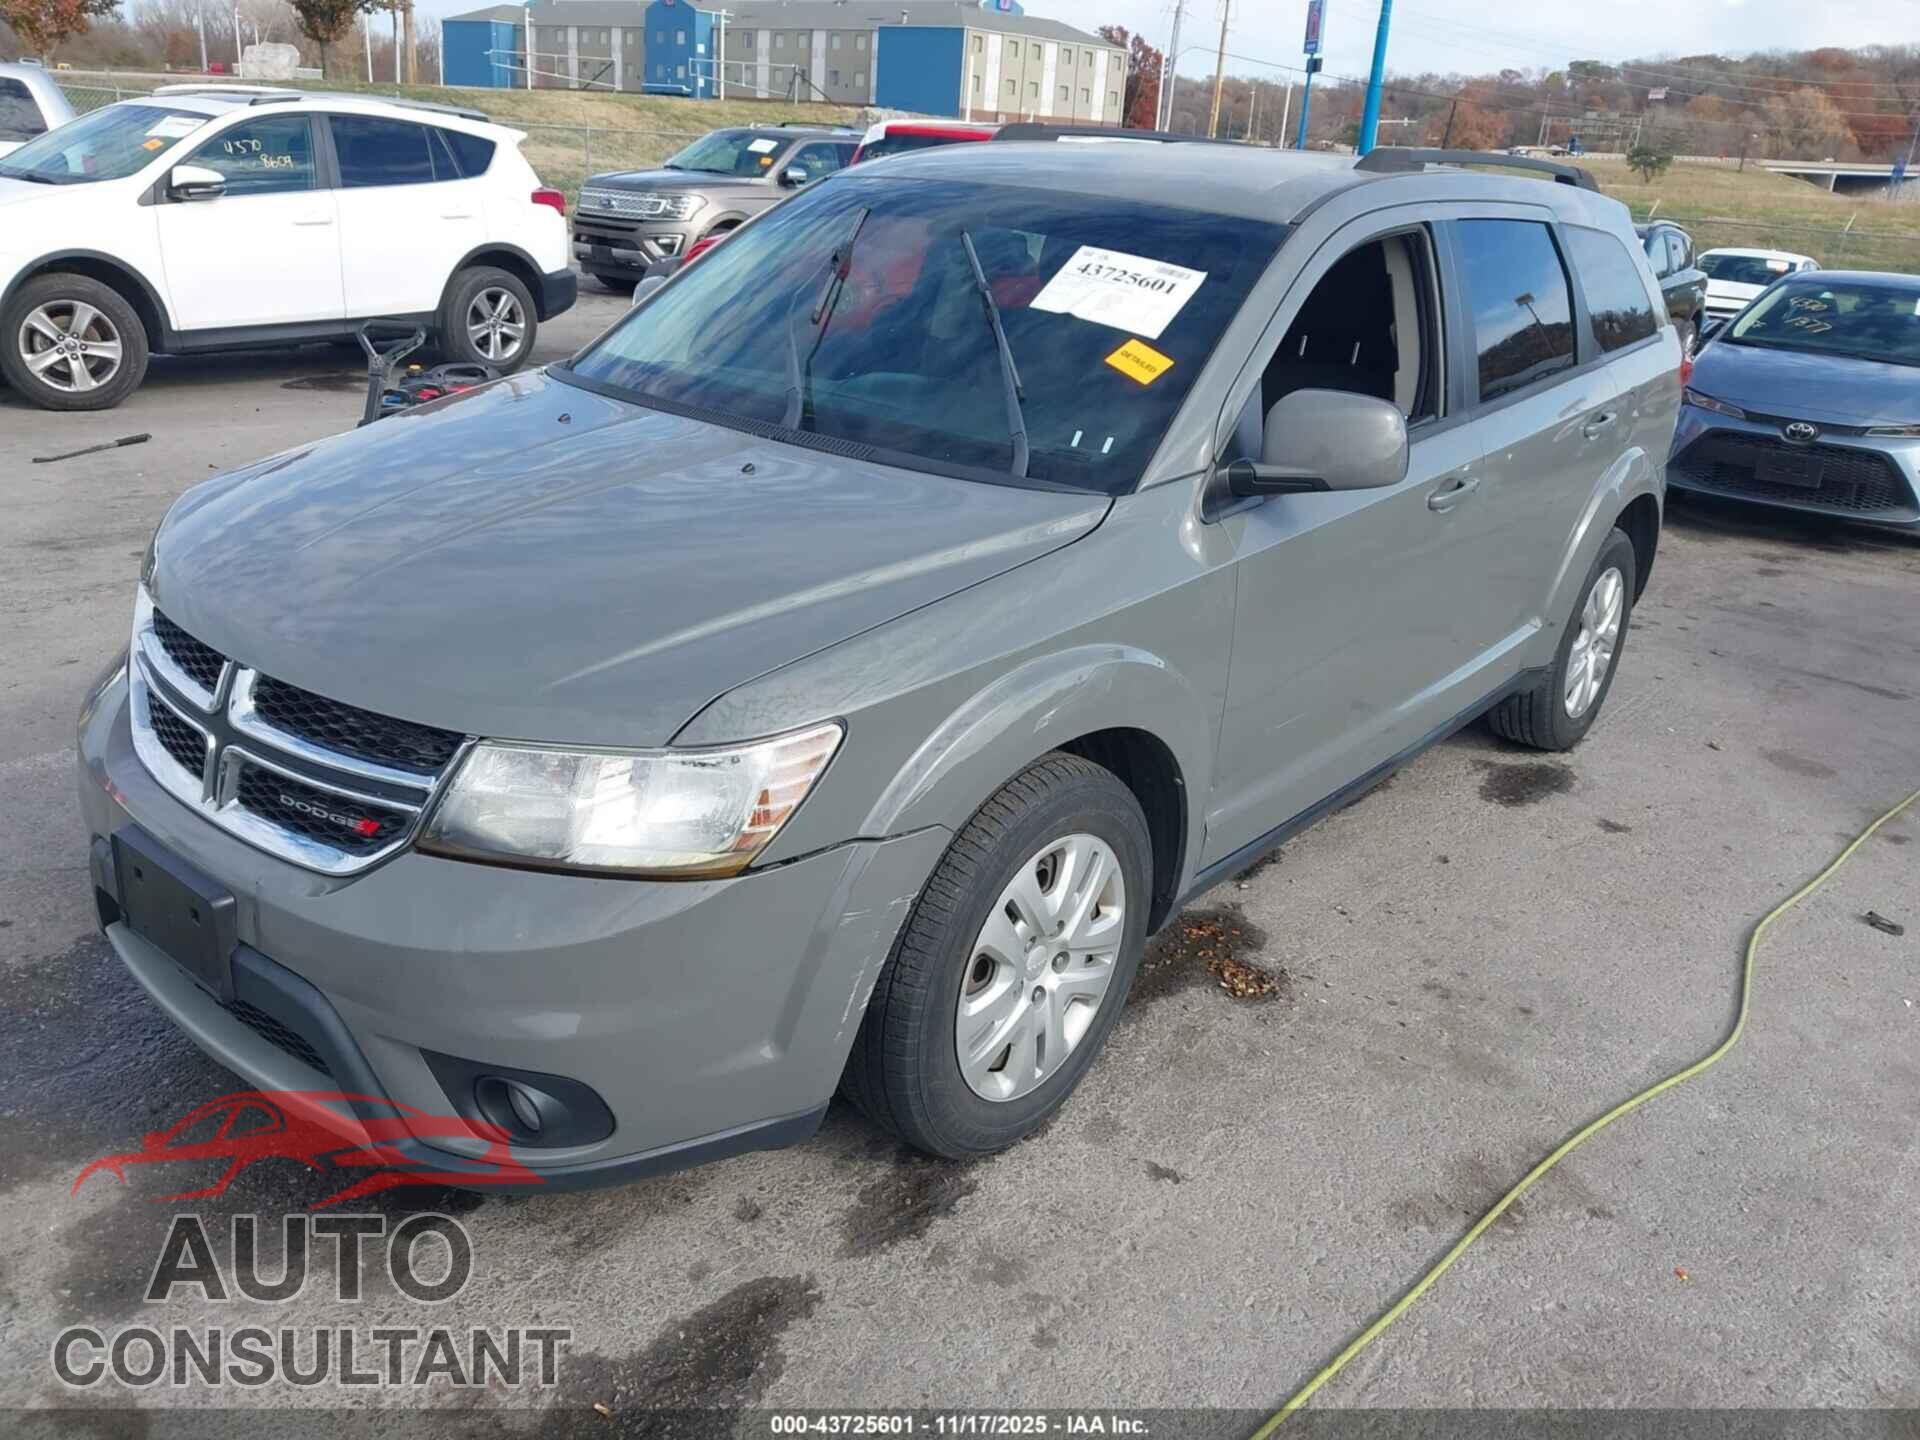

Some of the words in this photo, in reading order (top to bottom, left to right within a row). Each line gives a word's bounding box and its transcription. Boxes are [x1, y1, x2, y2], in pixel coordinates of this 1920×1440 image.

[1077, 261, 1177, 295] 43725601
[1120, 350, 1157, 373] DETAILED
[280, 794, 364, 831] DODGE
